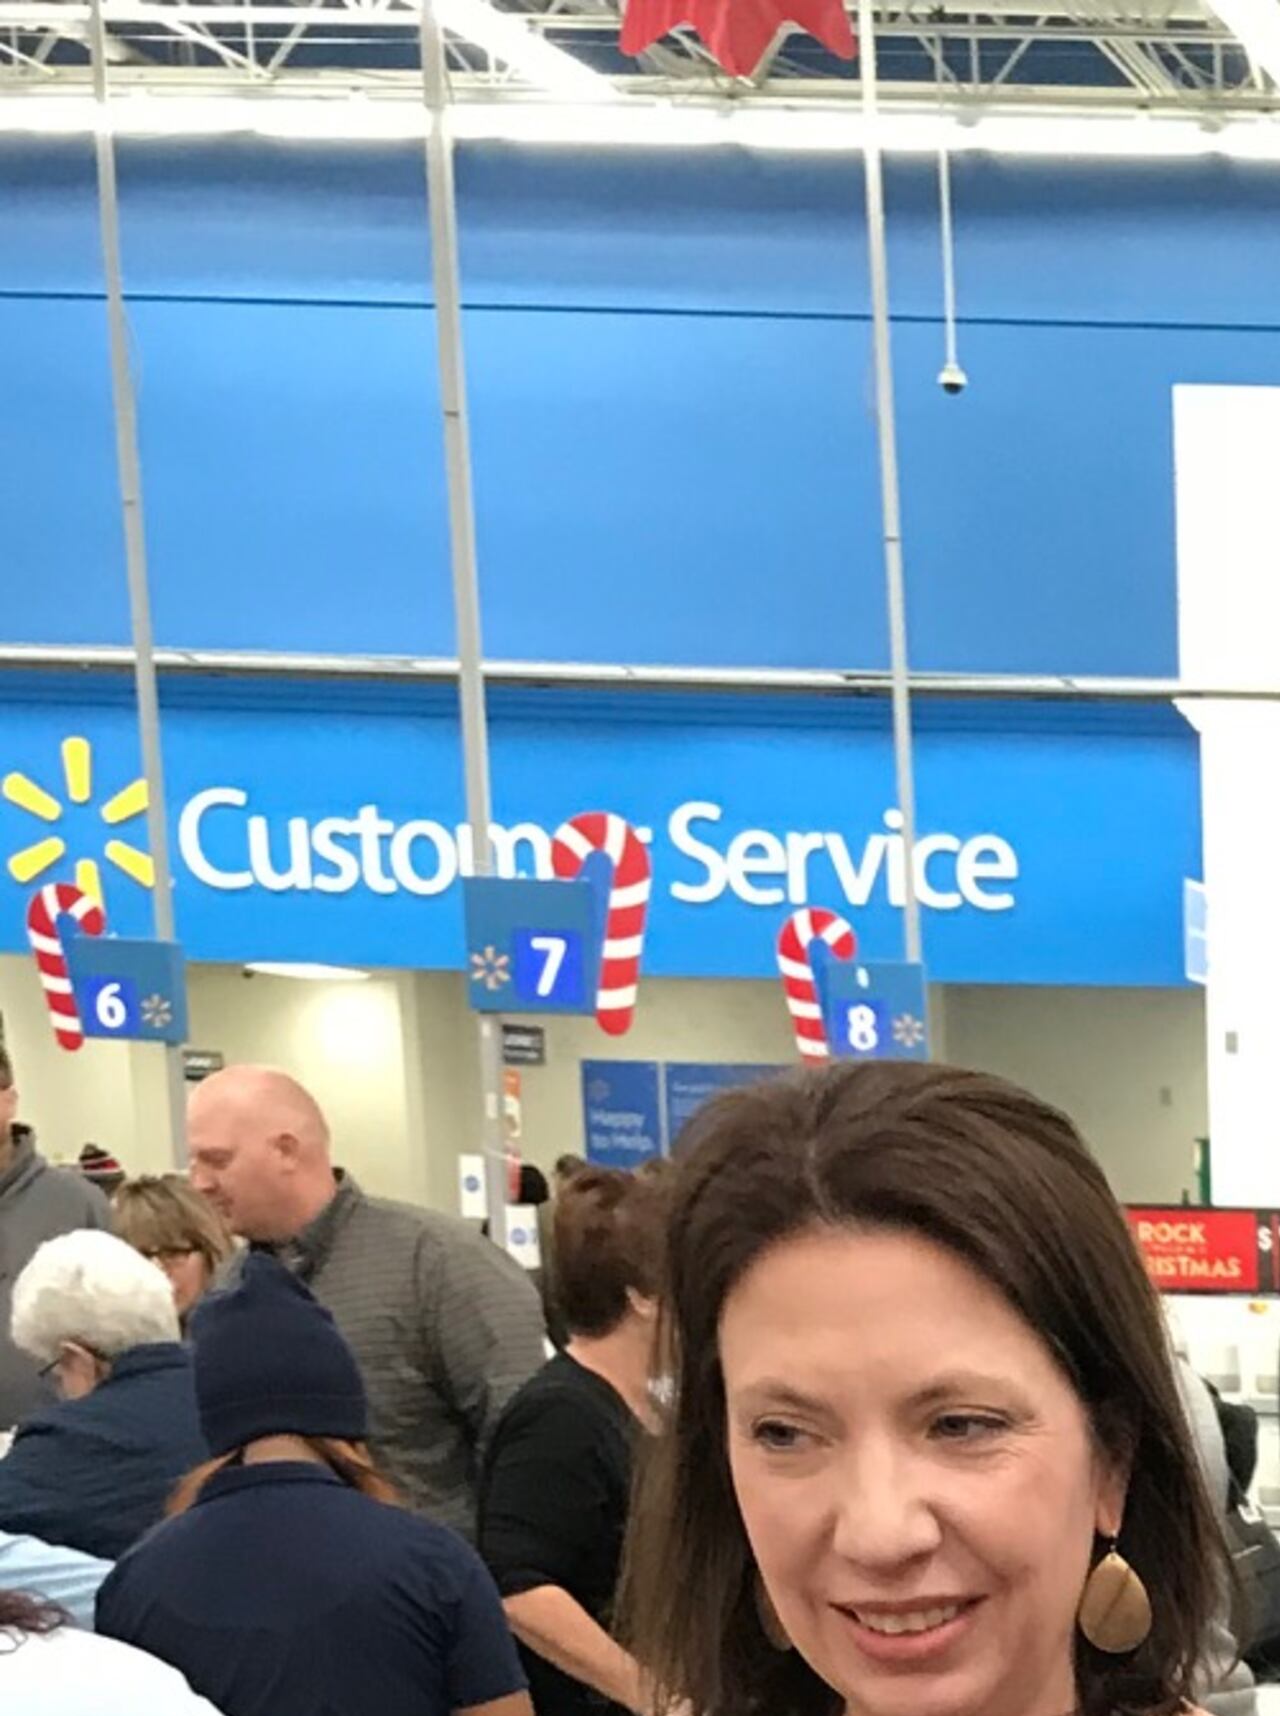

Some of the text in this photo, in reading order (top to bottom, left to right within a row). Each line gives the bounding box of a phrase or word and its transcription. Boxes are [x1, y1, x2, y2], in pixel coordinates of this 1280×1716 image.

[178, 788, 1019, 910] Custom Service
[530, 936, 567, 998] 7
[95, 982, 128, 1029] 6
[847, 1004, 878, 1052] 8
